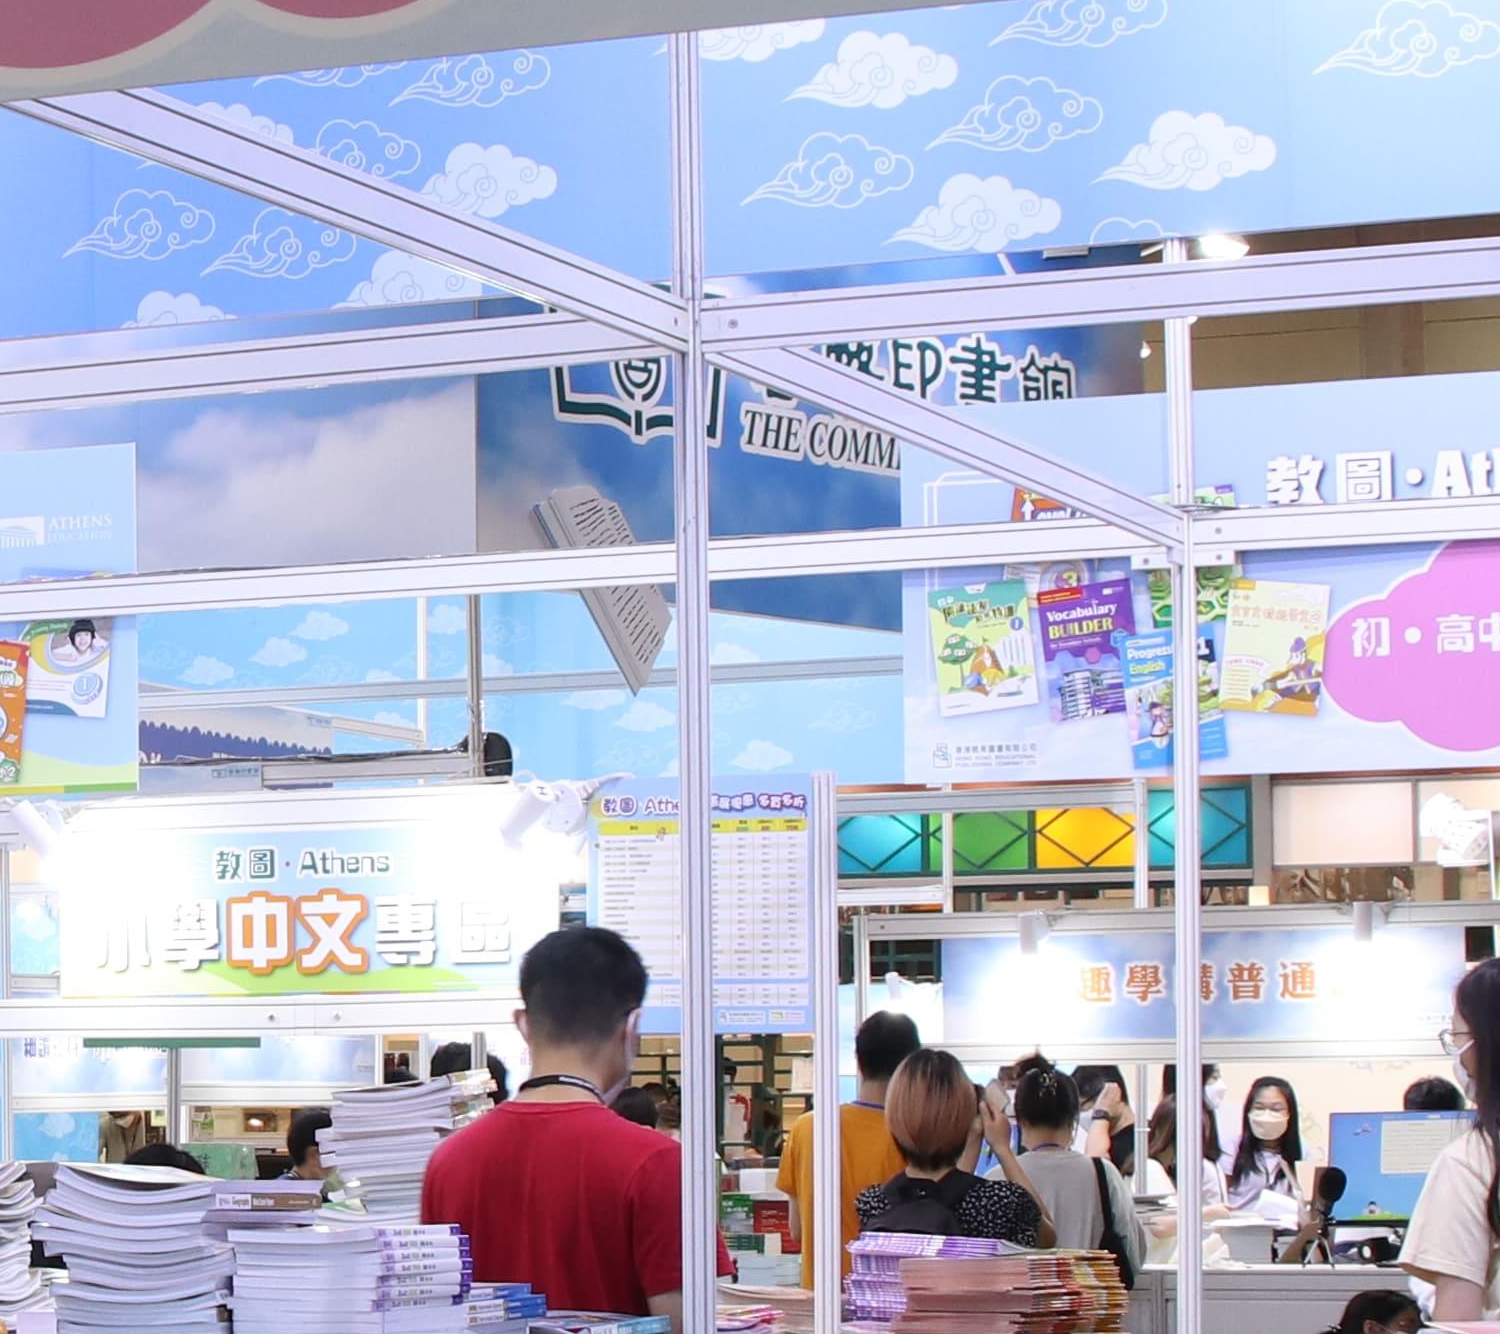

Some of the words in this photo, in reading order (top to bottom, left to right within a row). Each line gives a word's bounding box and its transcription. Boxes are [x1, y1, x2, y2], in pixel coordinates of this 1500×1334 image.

[742, 407, 803, 454] THE
[808, 419, 900, 470] COMM
[48, 513, 113, 532] ATHENS
[1045, 602, 1118, 623] Vocabulary
[1048, 617, 1115, 641] BUILDER
